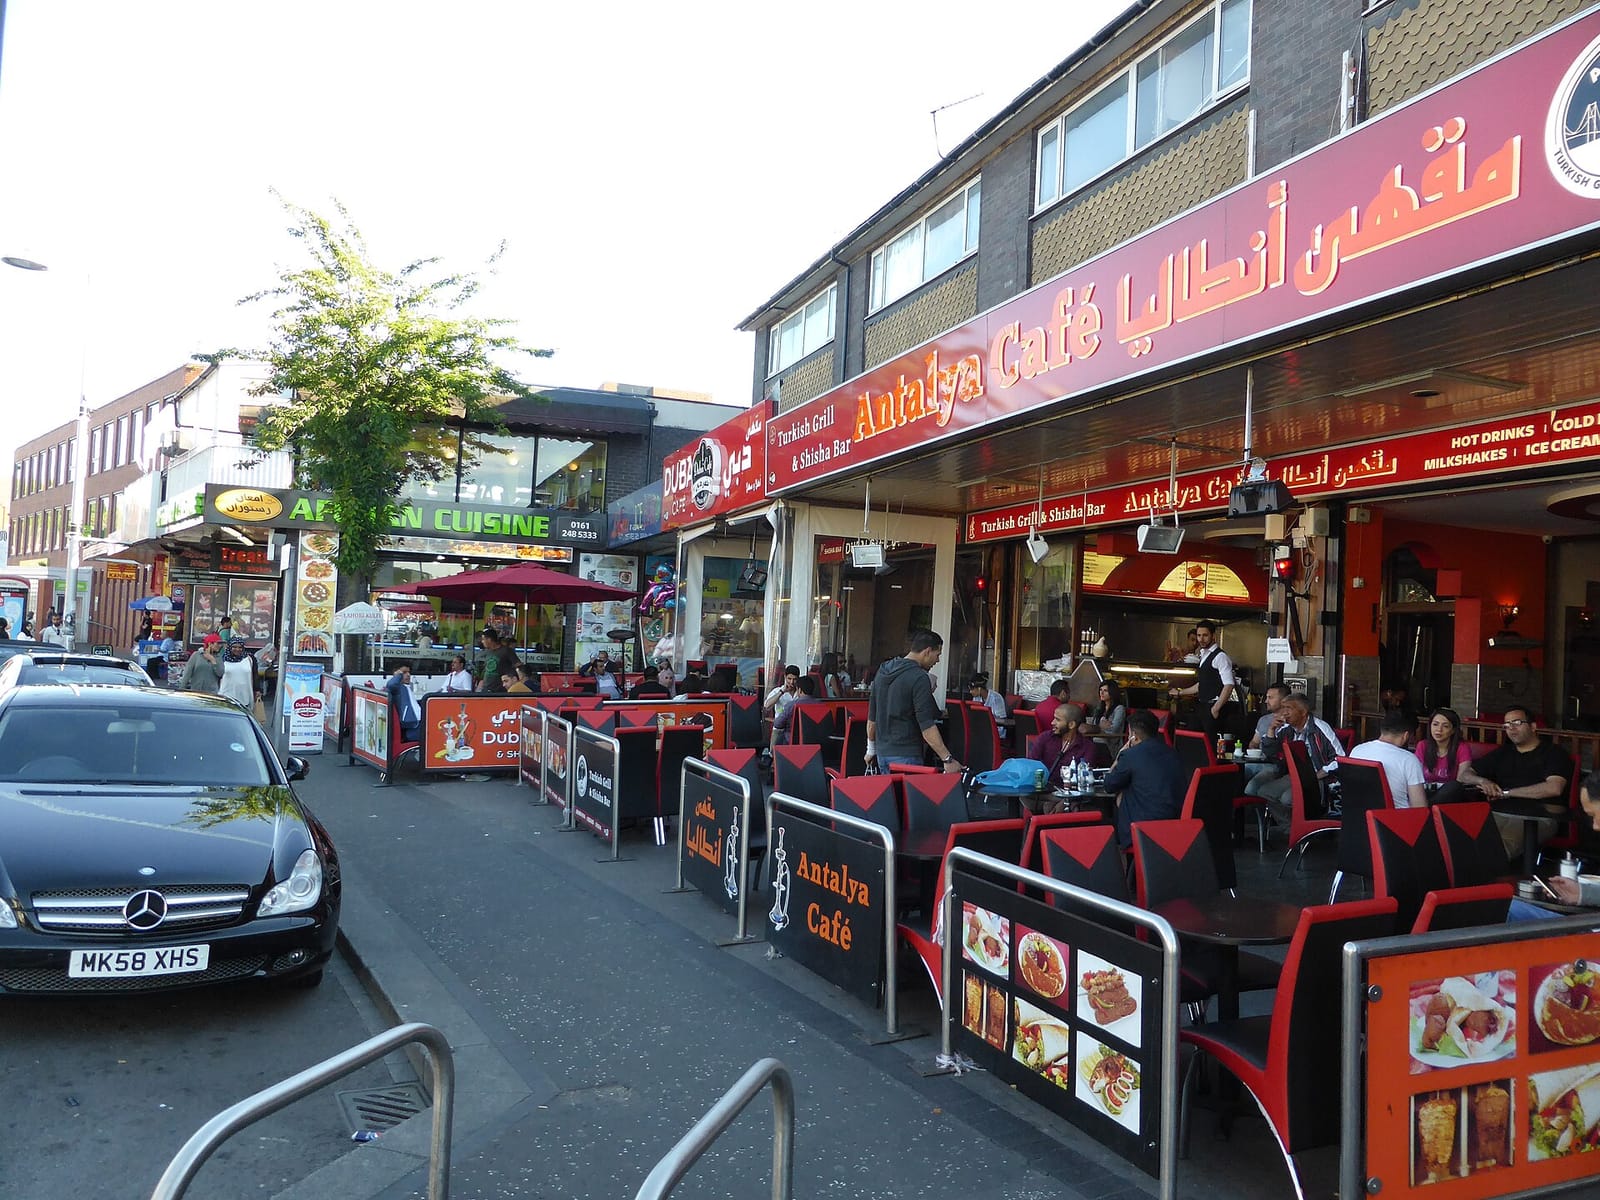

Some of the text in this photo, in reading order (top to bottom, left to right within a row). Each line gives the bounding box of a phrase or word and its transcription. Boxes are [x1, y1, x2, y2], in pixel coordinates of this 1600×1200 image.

[1553, 147, 1591, 188] TURKISH
[1116, 179, 1290, 358] أنطاليا
[853, 281, 1104, 443] Antalya Café
[777, 404, 835, 448] Turkish Grill
[1451, 433, 1481, 449] HOT
[1481, 424, 1535, 445] DRINKS
[1552, 414, 1595, 433] COLD
[791, 438, 852, 473] & Shisha Bar
[1424, 447, 1508, 471] MILKSHAKES
[1525, 441, 1550, 457] ICE
[663, 454, 693, 497] DUBA
[1123, 481, 1202, 513] Antalya
[433, 507, 550, 538] CUISINE
[561, 529, 598, 540] 248 5333
[571, 521, 590, 530] 0161
[981, 503, 1106, 533] Turkish Grill & Shisha Bar
[482, 731, 520, 744] Dub
[496, 750, 504, 759] &
[686, 818, 723, 868] أنطاليا
[796, 851, 870, 907] Antalya
[807, 902, 852, 951] Café
[80, 947, 200, 973] MK58 XHS
